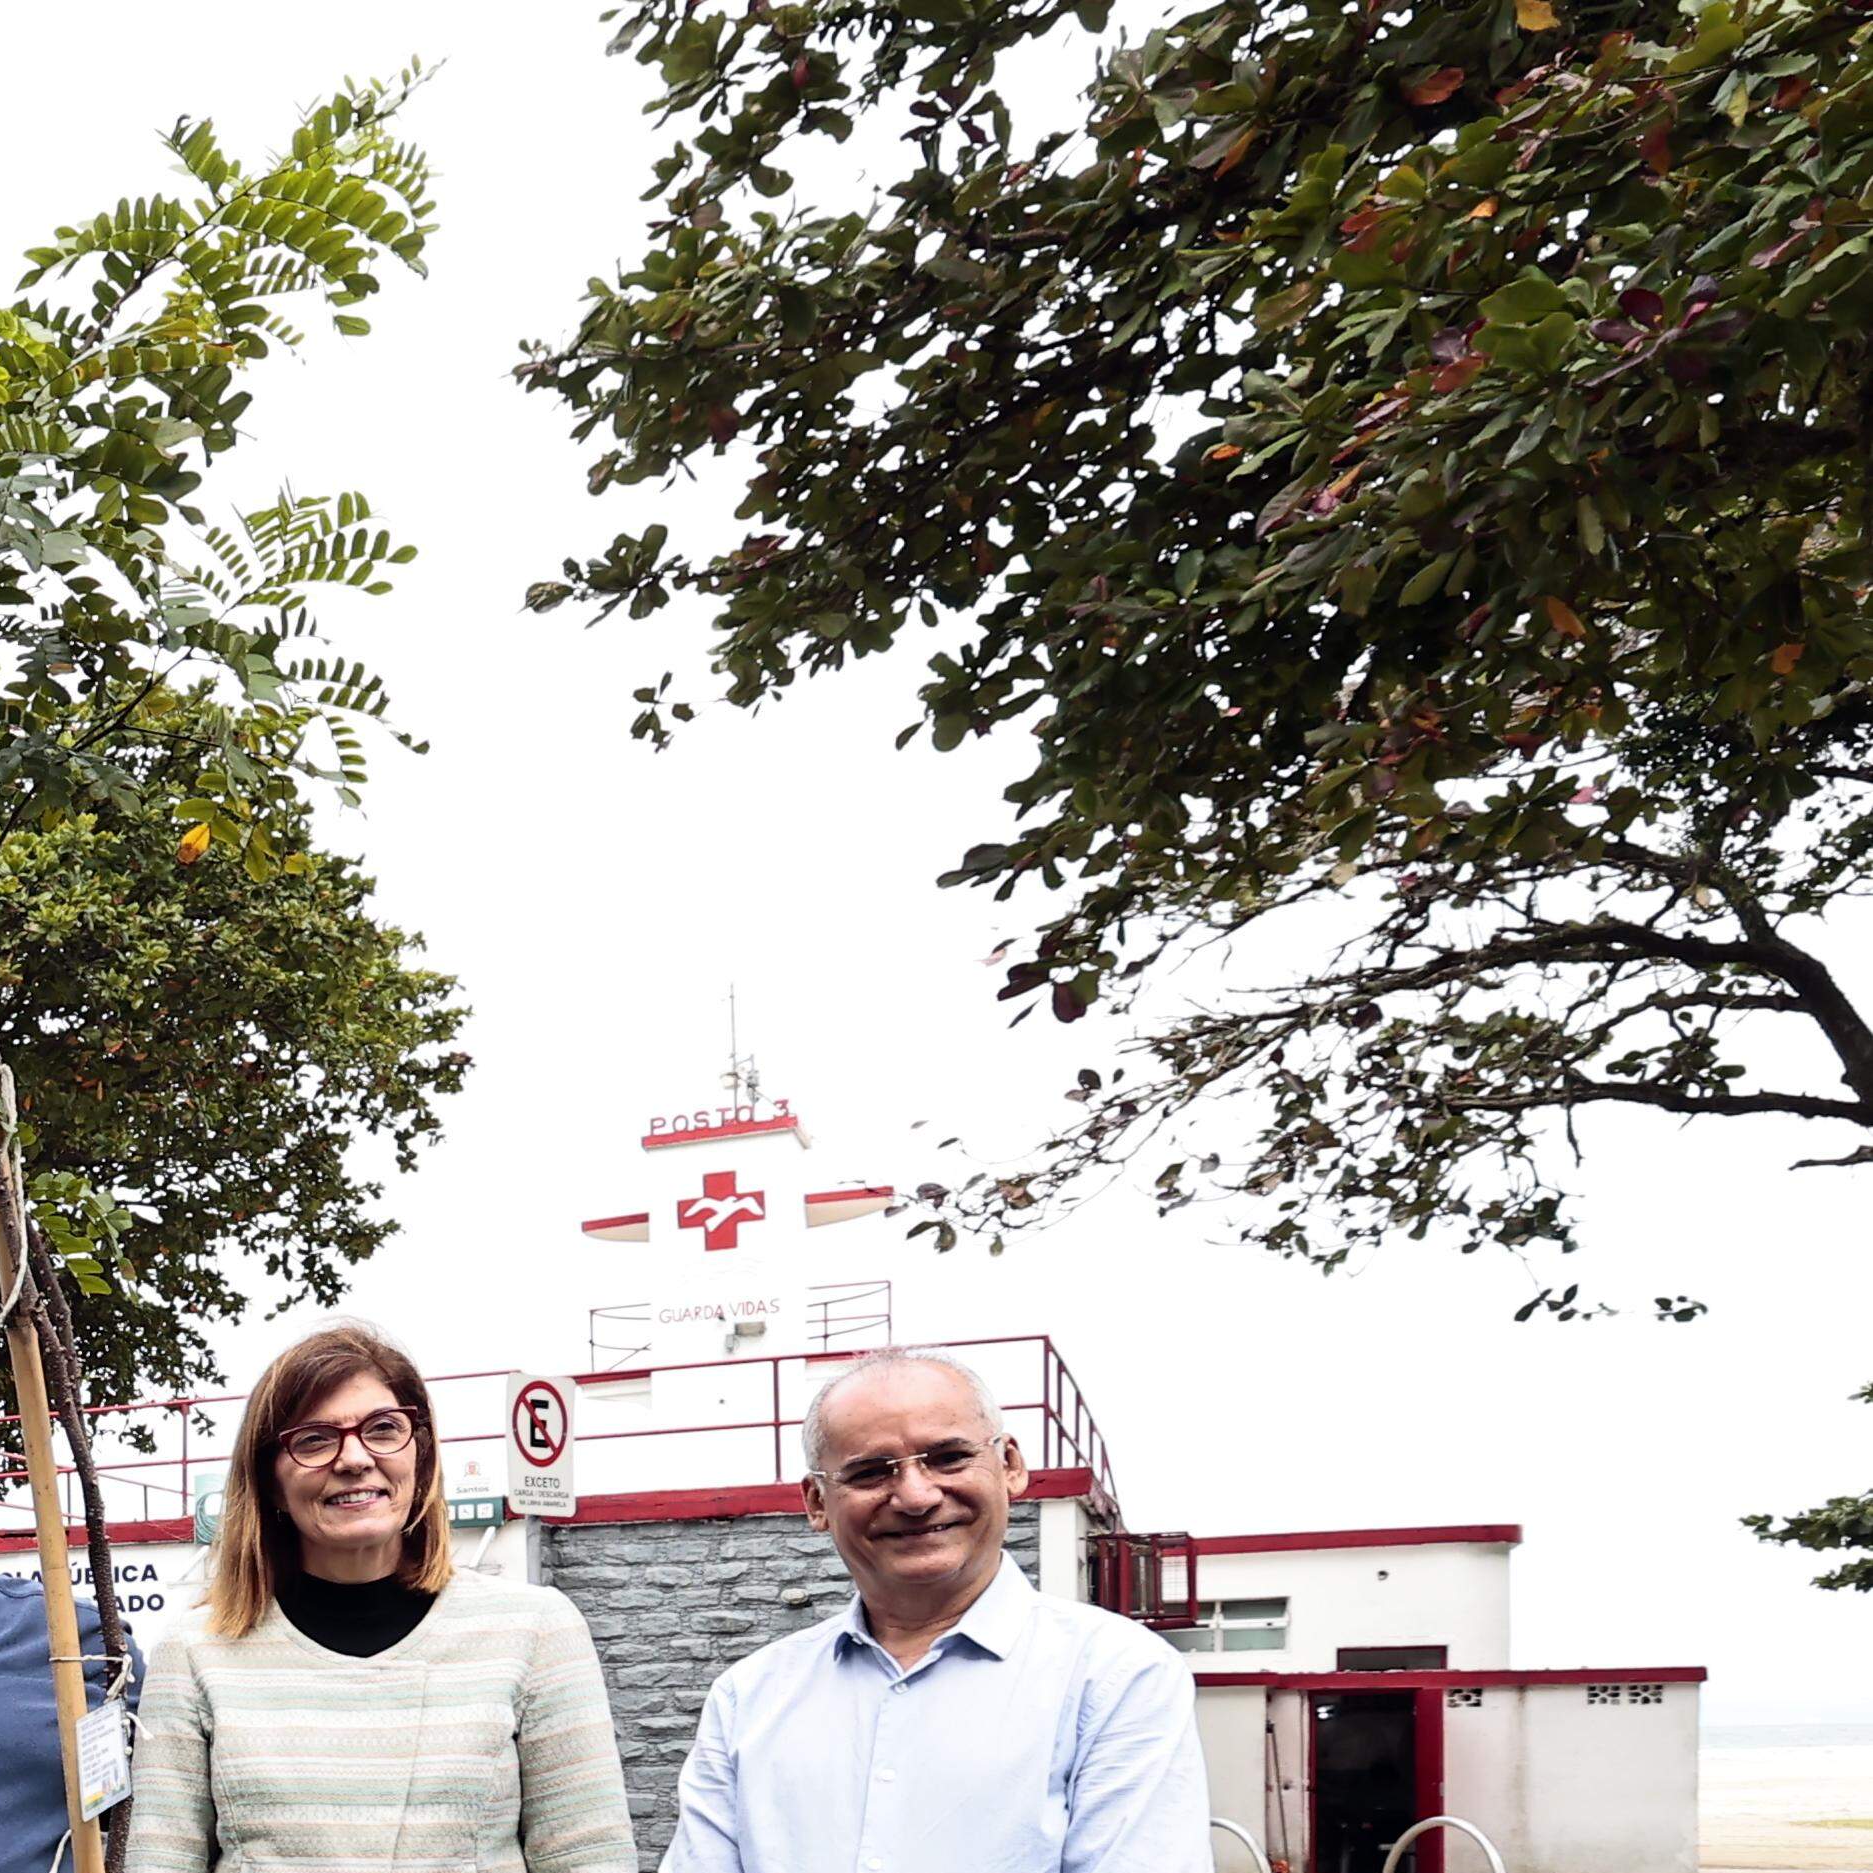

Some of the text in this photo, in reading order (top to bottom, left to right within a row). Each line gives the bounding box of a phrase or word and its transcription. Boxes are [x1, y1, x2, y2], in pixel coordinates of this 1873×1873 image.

[650, 1099, 789, 1136] POSTO 3
[659, 1299, 780, 1323] GUARDA VIDAS
[524, 1476, 560, 1489] EXCETO
[70, 1562, 158, 1586] ÚBICA
